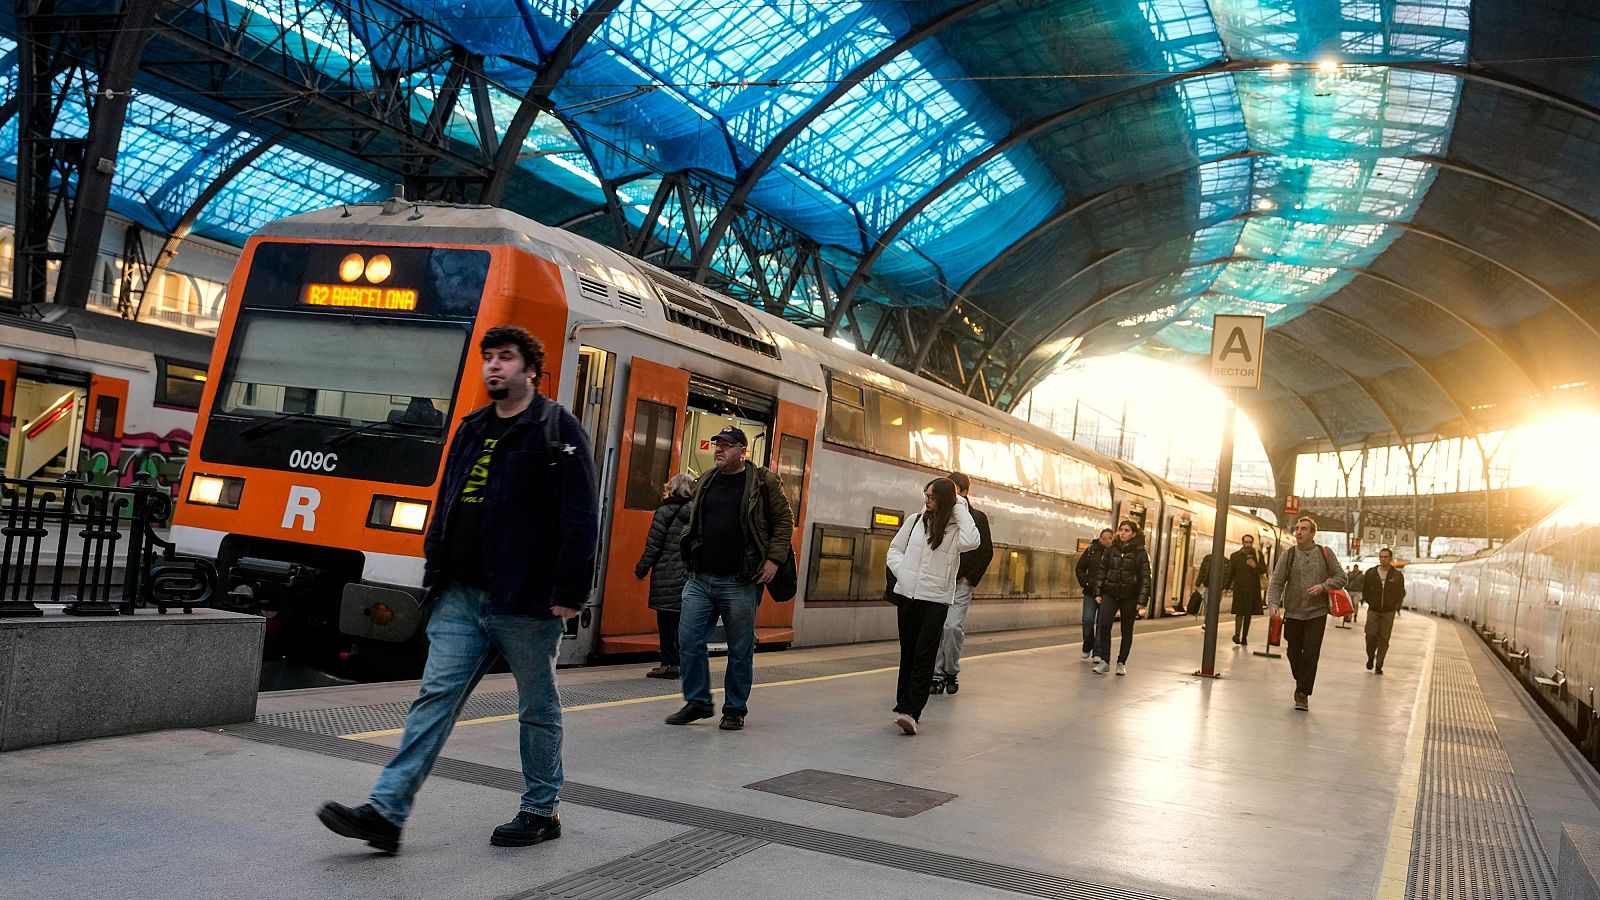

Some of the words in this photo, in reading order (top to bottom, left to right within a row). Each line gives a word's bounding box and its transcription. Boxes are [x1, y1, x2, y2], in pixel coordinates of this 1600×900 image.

[309, 285, 329, 305] R2
[331, 286, 416, 310] BARCELONA
[1218, 326, 1252, 362] A
[1214, 367, 1255, 377] SECTOR
[289, 449, 338, 472] 009C
[281, 485, 321, 532] R
[1368, 529, 1376, 540] 5
[1401, 533, 1409, 543] 4
